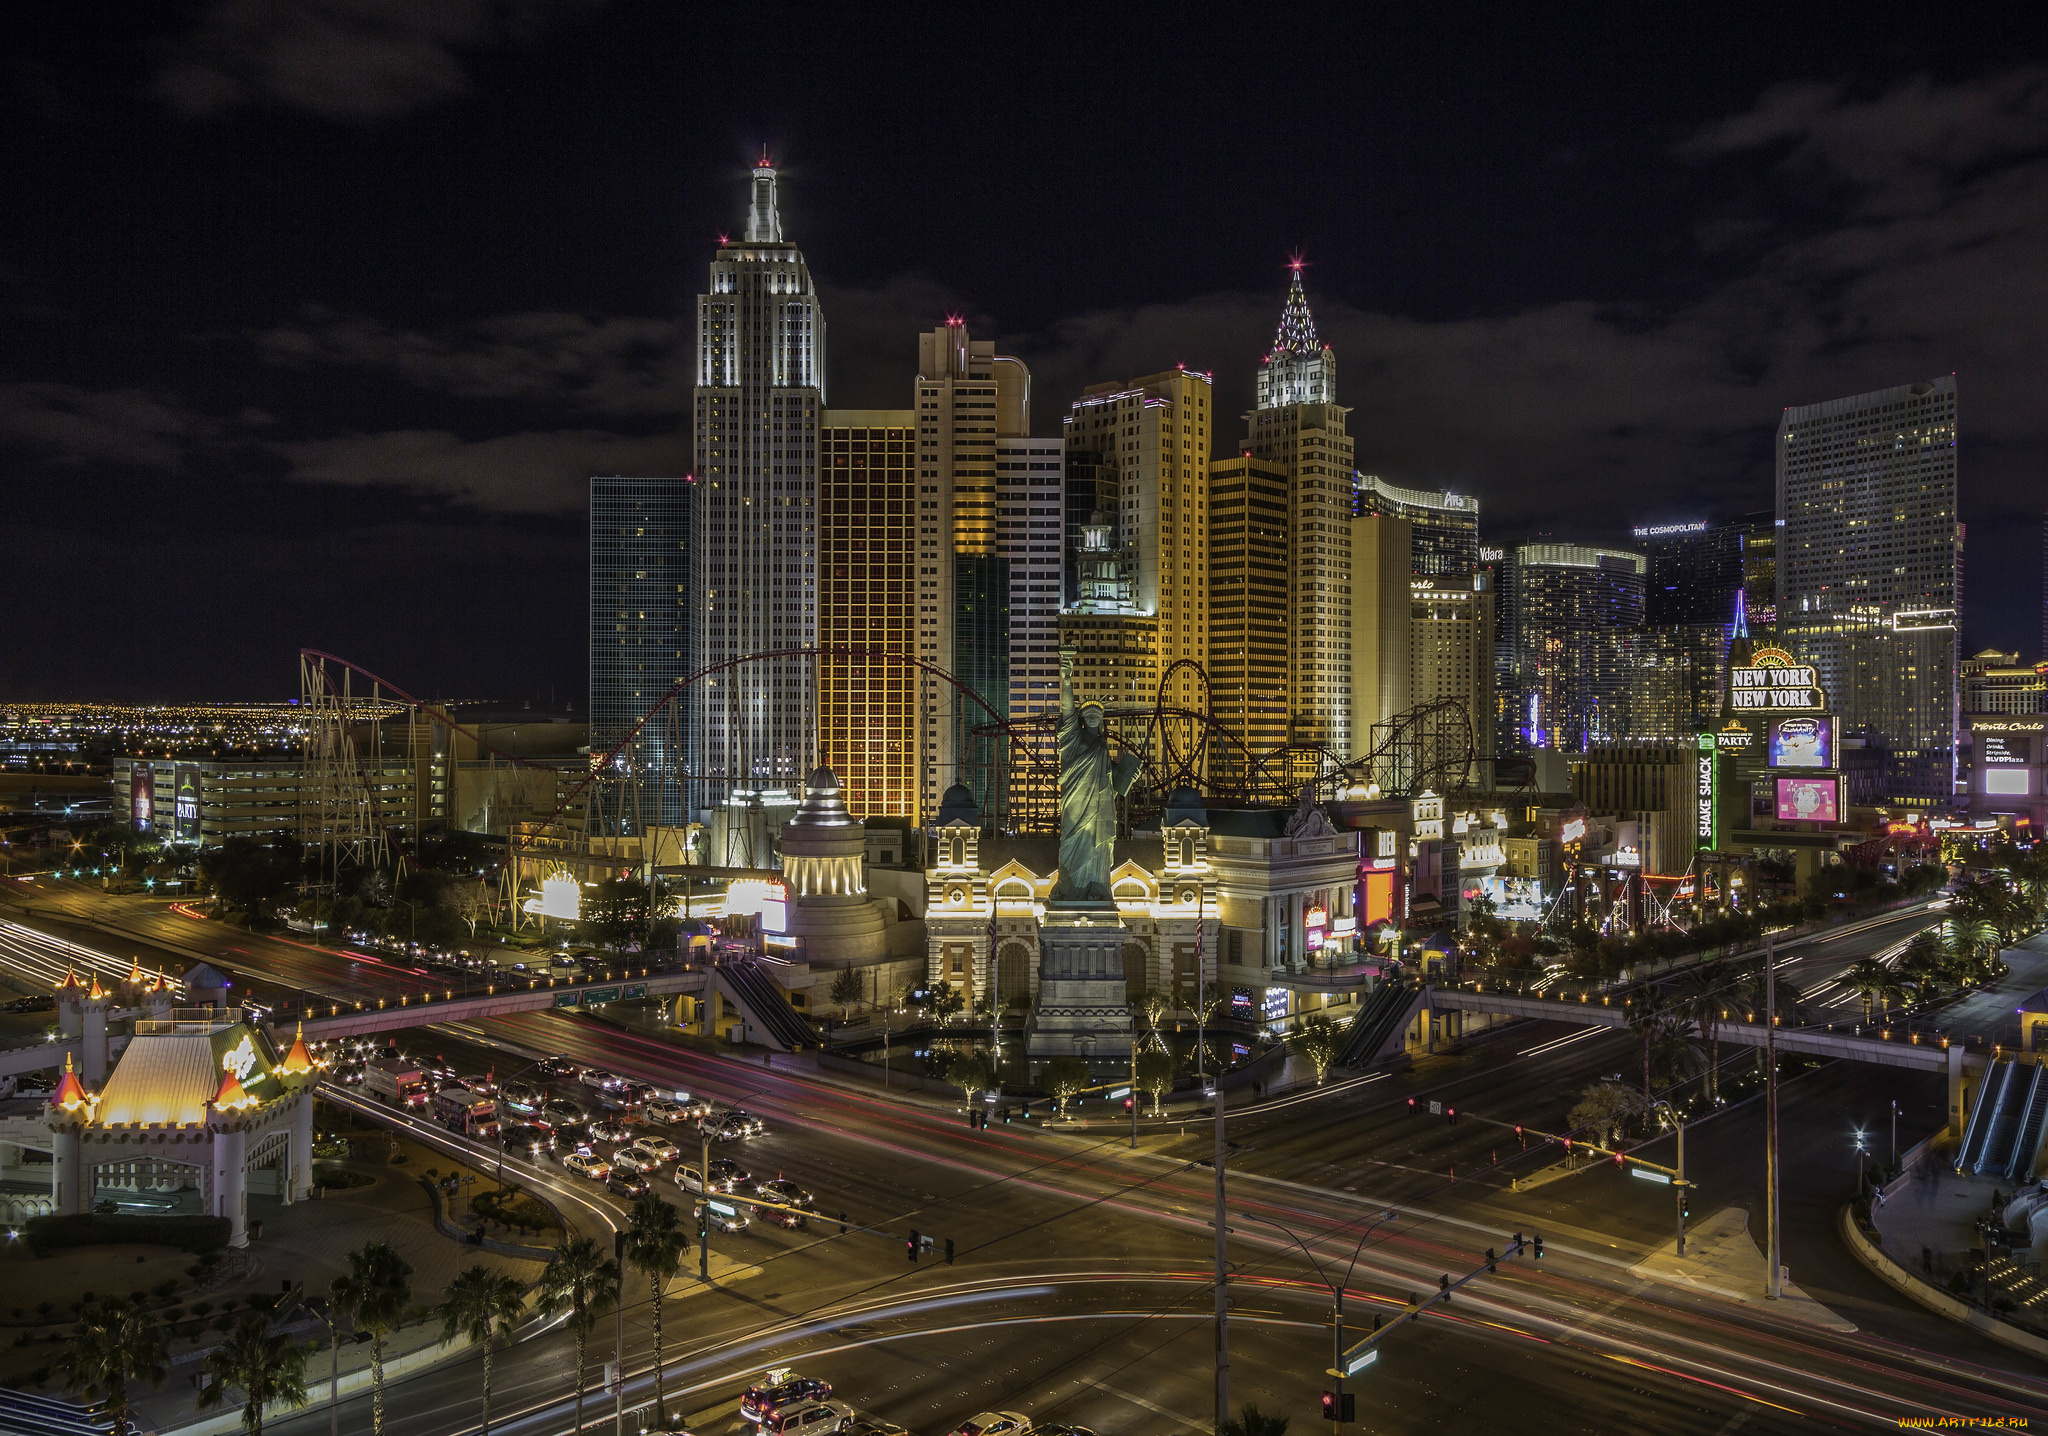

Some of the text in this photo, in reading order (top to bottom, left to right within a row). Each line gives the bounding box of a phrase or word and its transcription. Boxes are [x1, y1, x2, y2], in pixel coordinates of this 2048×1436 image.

[1634, 523, 1705, 536] THE COSMOPOLITAN
[1480, 547, 1503, 561] Vdara
[1732, 669, 1812, 687] NEW YORK
[1732, 690, 1812, 707] NEW YORK
[1972, 722, 2045, 731] Monte Carlo
[1718, 736, 1752, 746] PARTY.
[1700, 757, 1712, 837] SHAKE SHACK
[177, 803, 198, 819] PARTY.
